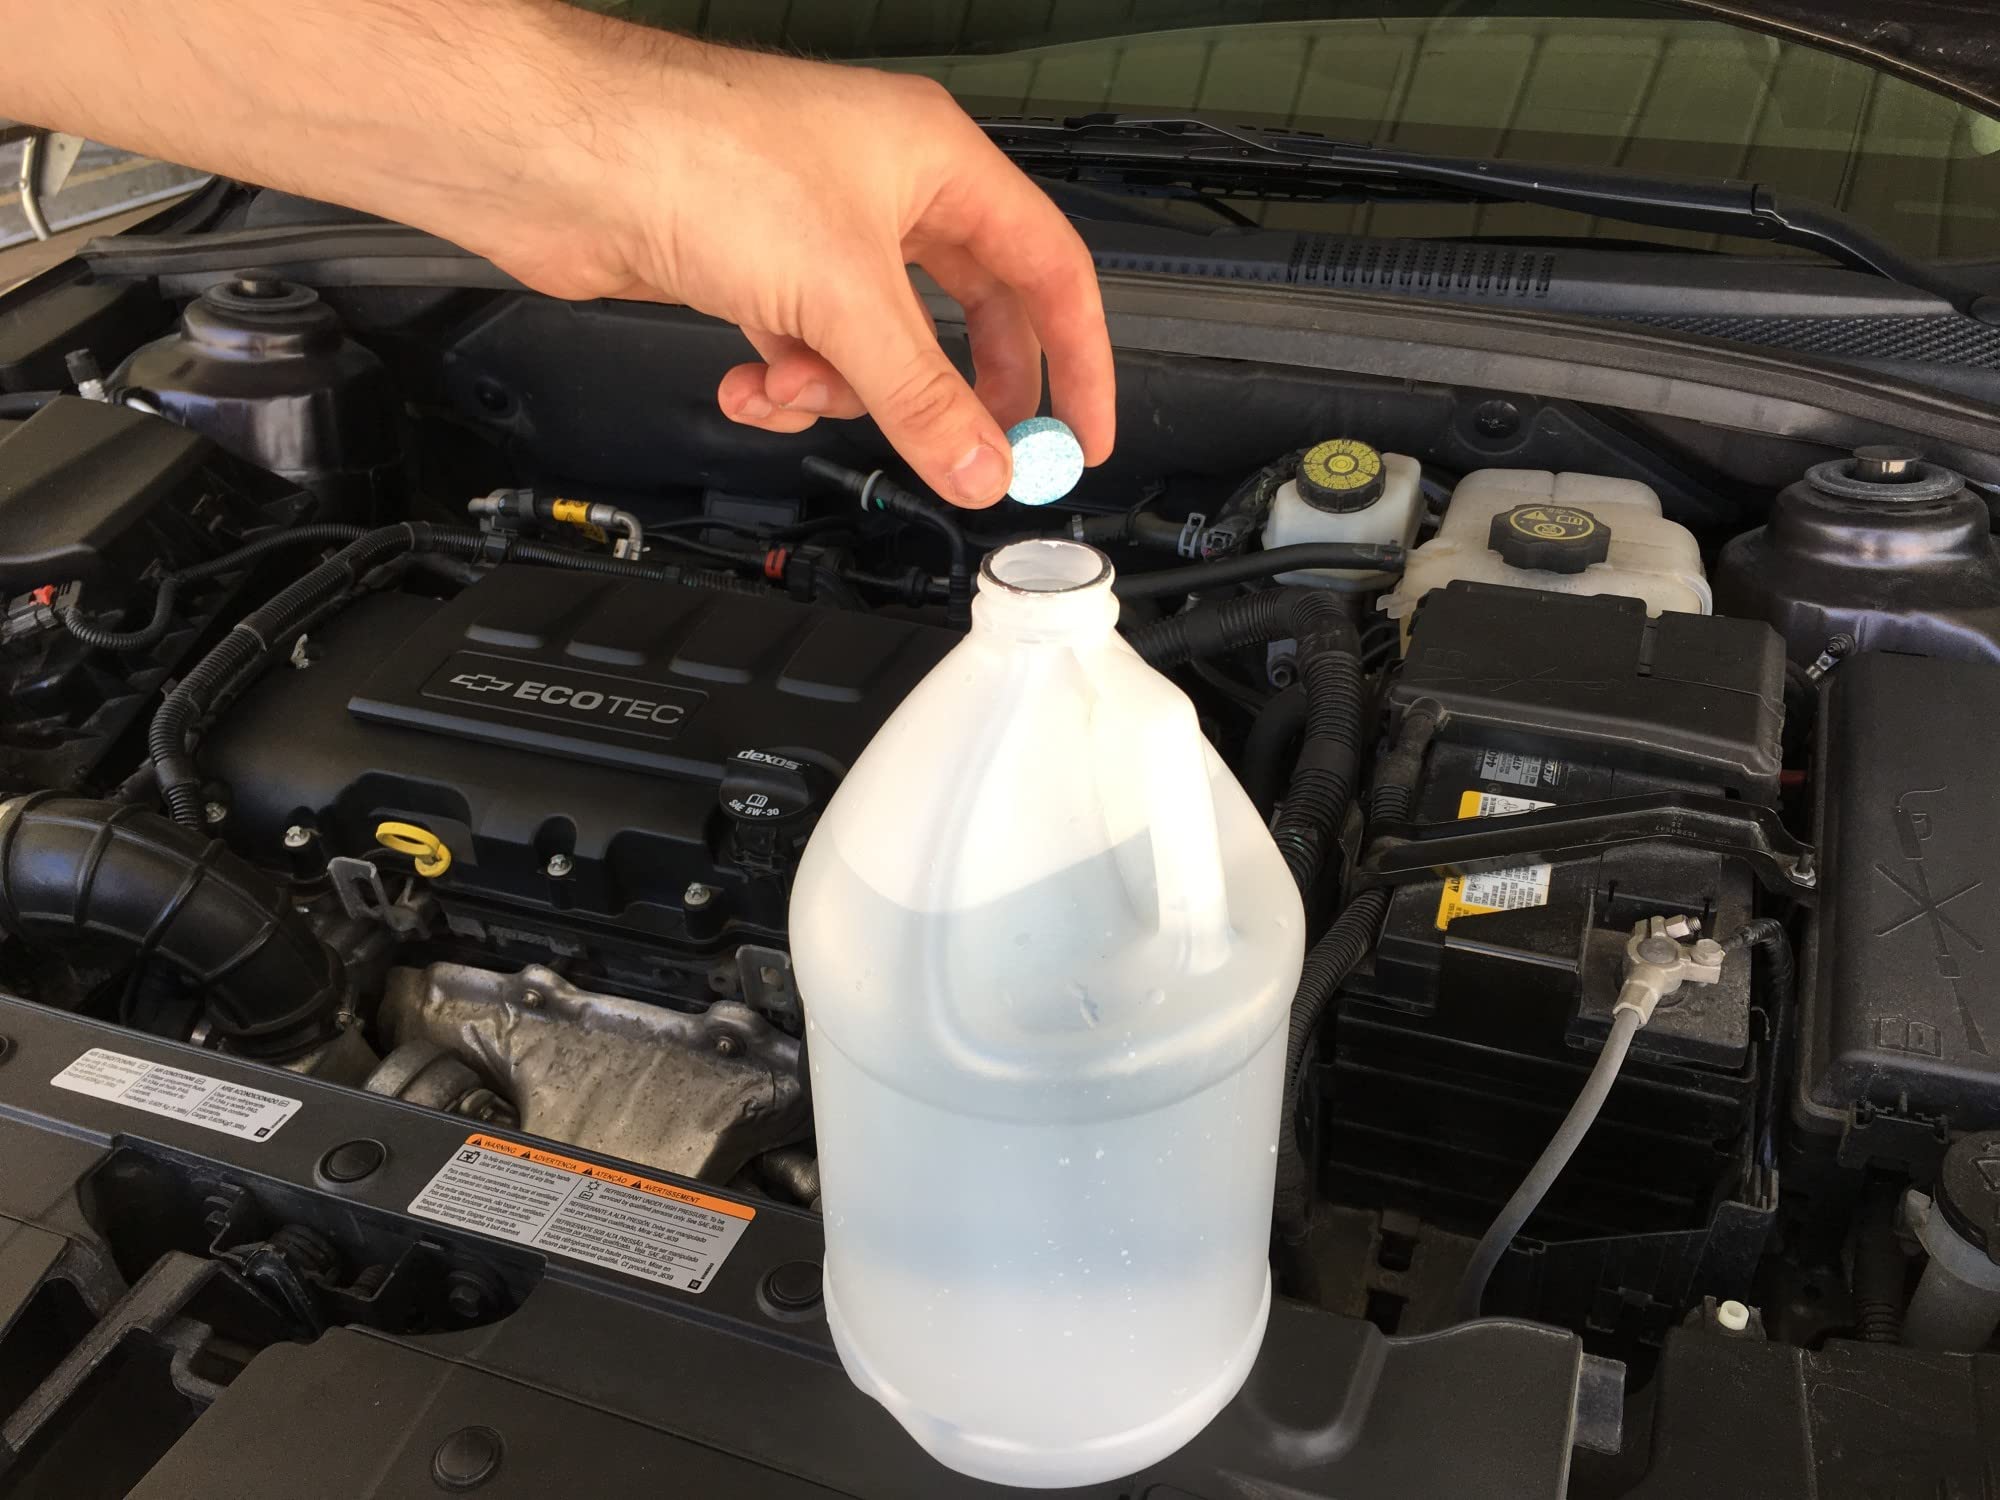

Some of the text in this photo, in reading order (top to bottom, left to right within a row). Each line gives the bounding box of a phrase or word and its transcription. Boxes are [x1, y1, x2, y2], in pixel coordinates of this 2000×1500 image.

[513, 680, 684, 724] ECOTEC
[737, 749, 800, 770] dexos
[729, 799, 780, 816] SAE 5W-30
[483, 1141, 701, 1203] WARNING ADVERTENCIA ATENÇÃO AVERTISSEMENT
[598, 1194, 622, 1204] serviced
[628, 1202, 653, 1212] qualified
[651, 1208, 675, 1218] persons
[685, 1217, 699, 1225] See
[697, 1220, 710, 1228] SAE
[603, 1188, 642, 1202] REFRIGERANT
[641, 1198, 664, 1208] UNDER
[662, 1203, 679, 1212] HIGH
[554, 1218, 594, 1233] REFRIGERANTE
[592, 1228, 606, 1236] SOB
[604, 1232, 619, 1240] ALTA
[643, 1243, 660, 1251] Deve
[667, 1249, 701, 1263] manipulado
[567, 1201, 608, 1215] REFRIGERANTE
[612, 1213, 628, 1221] ALTA
[651, 1223, 667, 1232] Debe
[674, 1230, 709, 1243] manipulado
